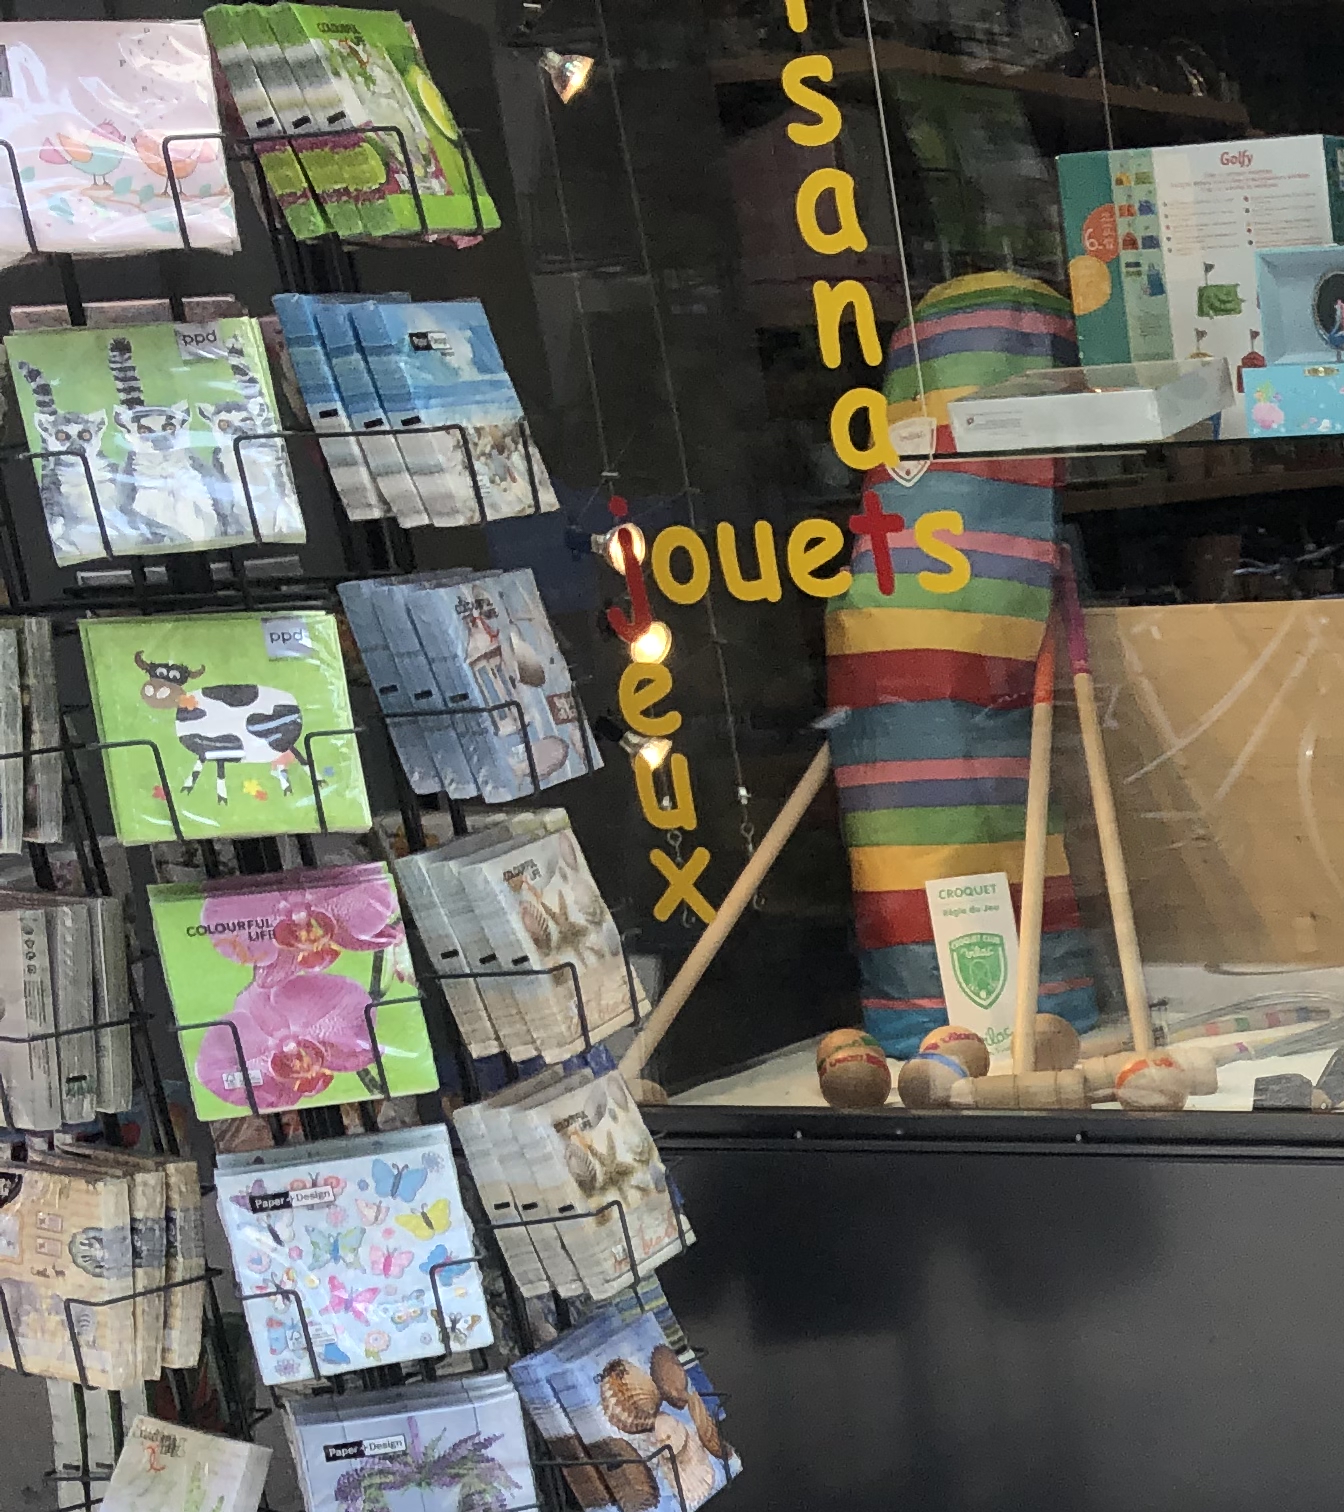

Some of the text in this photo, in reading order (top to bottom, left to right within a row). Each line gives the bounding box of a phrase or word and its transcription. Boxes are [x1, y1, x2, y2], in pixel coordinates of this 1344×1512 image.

[1220, 150, 1254, 168] Golfy
[182, 329, 217, 346] ppd
[606, 493, 970, 643] jouets
[269, 628, 303, 645] ppd
[938, 884, 997, 900] CROQUET
[186, 918, 273, 938] COLOURFUL
[255, 1190, 331, 1210] Paper Design
[328, 1438, 403, 1458] Paper Design
